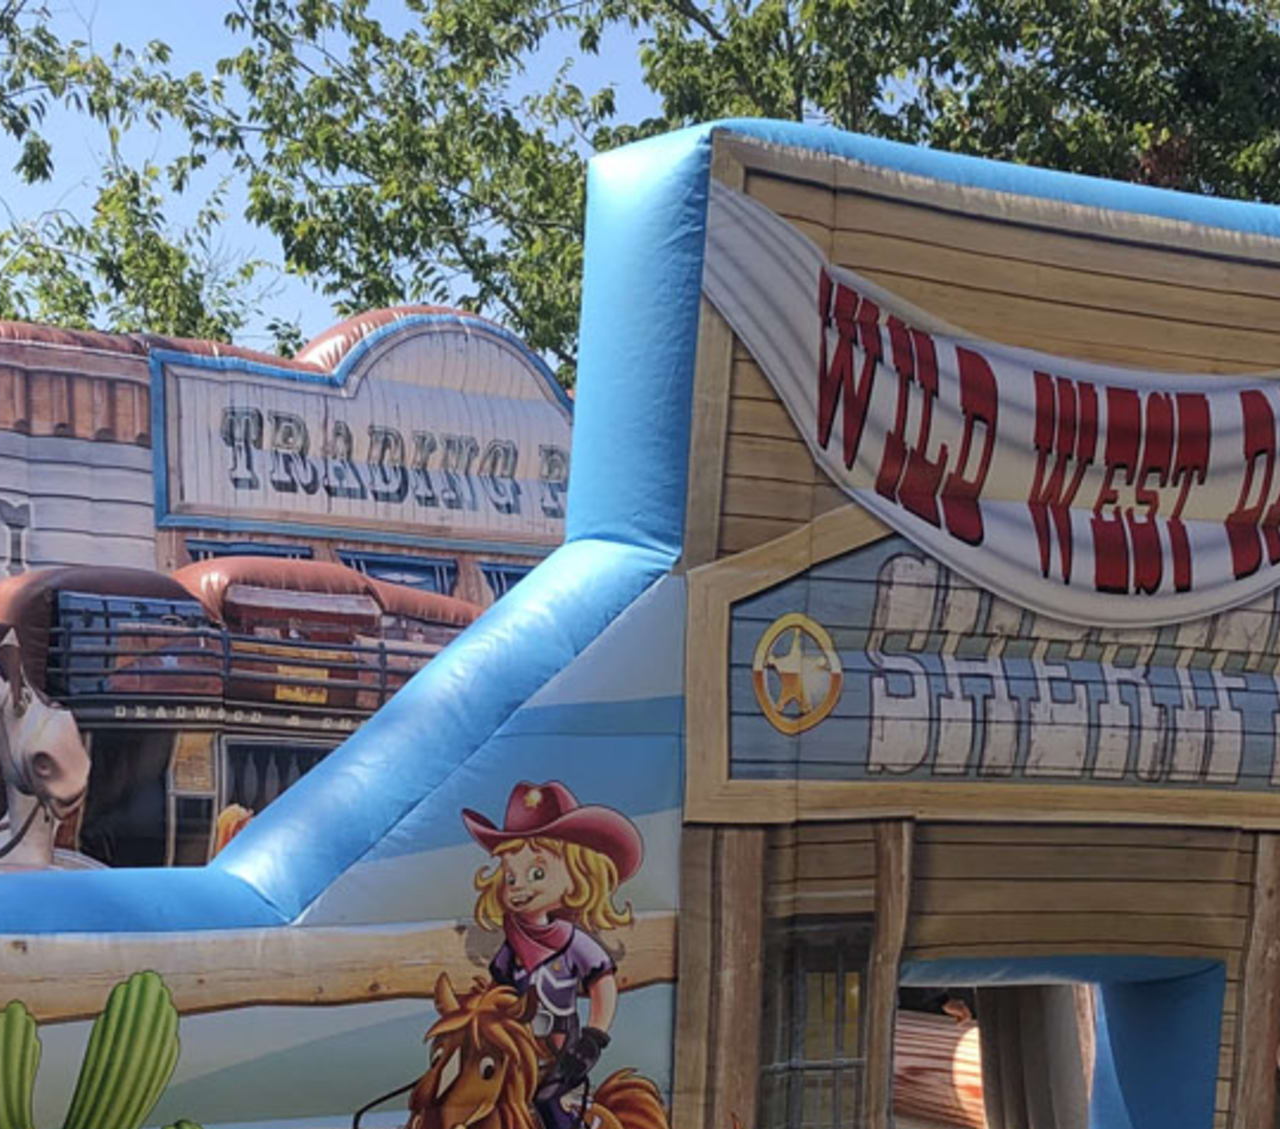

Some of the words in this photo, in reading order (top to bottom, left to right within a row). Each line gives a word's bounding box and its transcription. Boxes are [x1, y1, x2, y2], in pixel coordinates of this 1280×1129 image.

[220, 405, 522, 515] TRADING
[816, 266, 999, 546] WILD
[1029, 370, 1211, 596] WEST
